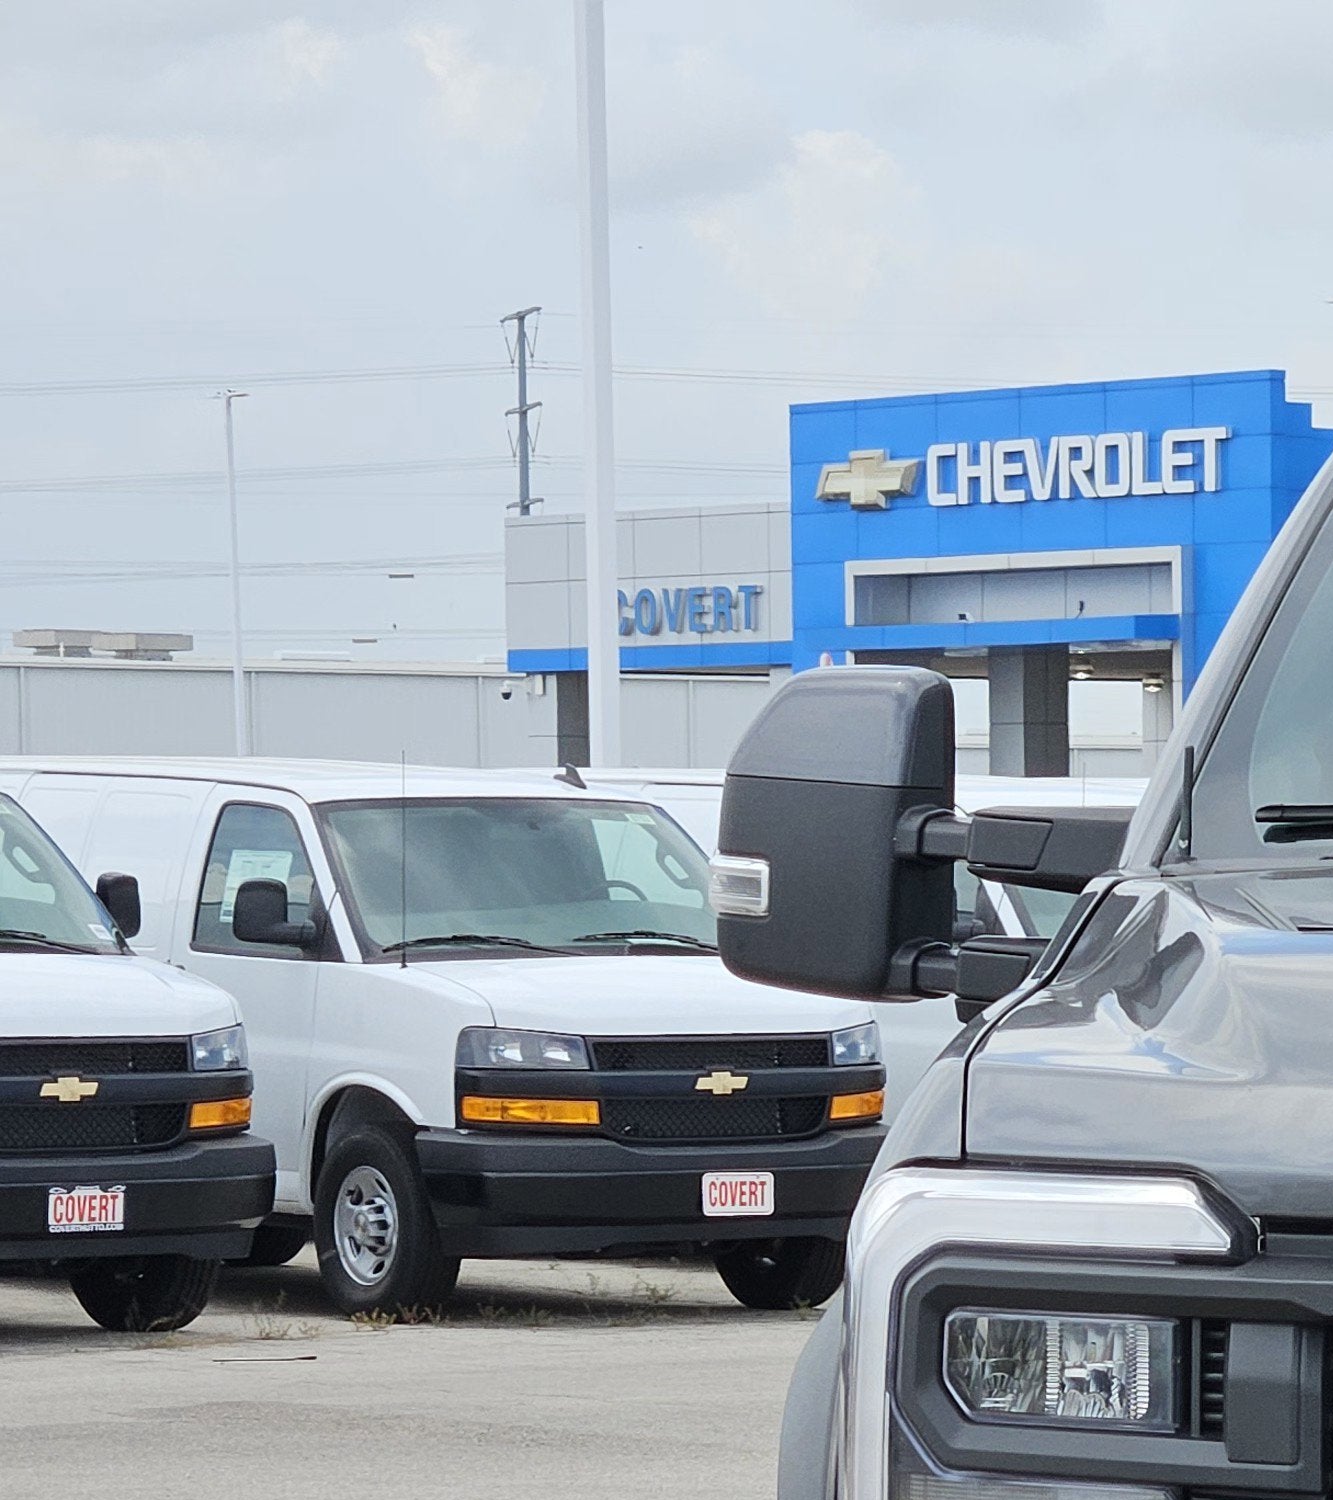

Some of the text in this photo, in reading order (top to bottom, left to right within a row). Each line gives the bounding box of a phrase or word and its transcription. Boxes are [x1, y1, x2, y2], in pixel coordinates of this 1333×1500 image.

[927, 426, 1231, 507] CHEVROLET
[617, 585, 760, 636] COVERT
[54, 1195, 118, 1223] COVERT
[709, 1181, 767, 1207] COVERT
